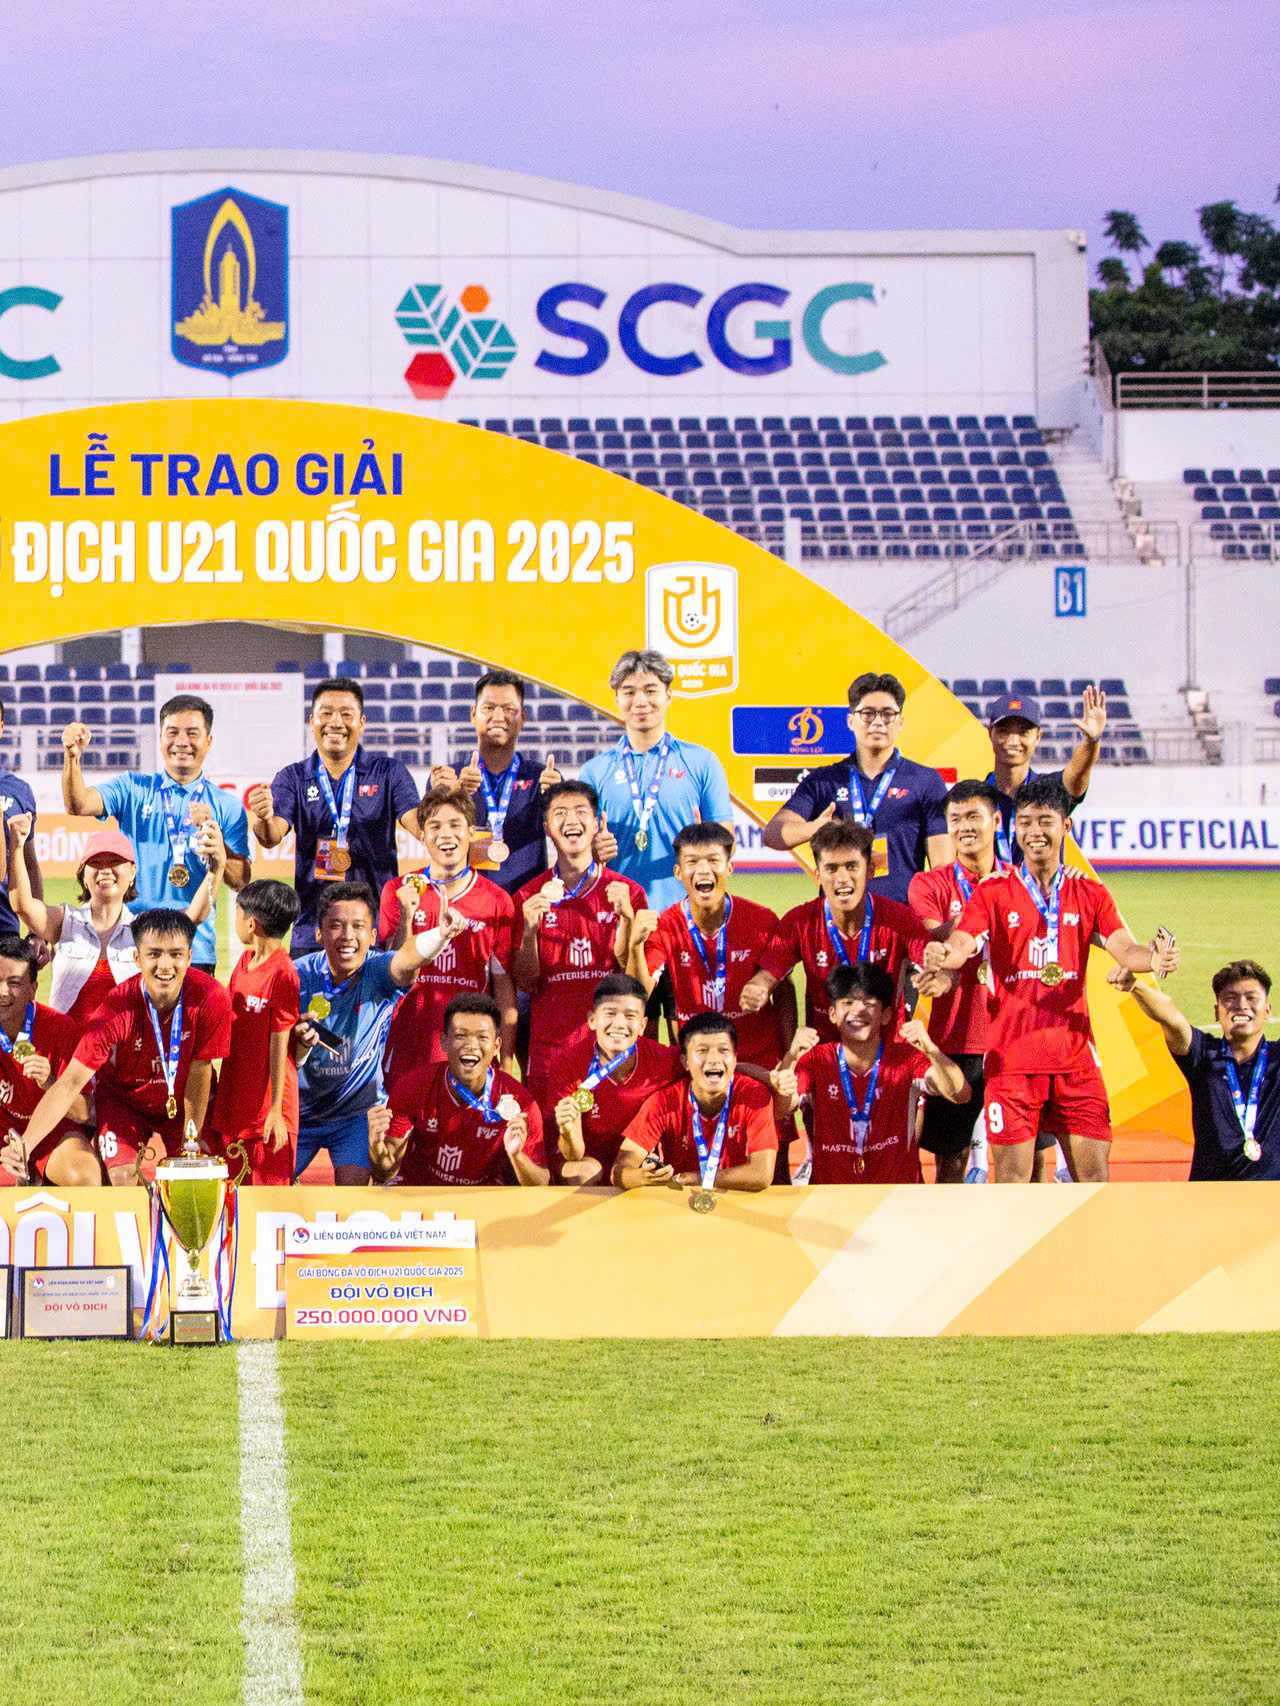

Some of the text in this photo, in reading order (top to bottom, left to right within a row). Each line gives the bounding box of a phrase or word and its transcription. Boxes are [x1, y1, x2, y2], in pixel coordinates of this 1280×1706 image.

[534, 281, 888, 377] SCGC
[50, 432, 404, 497] LỄ TRAO GIẢI
[10, 519, 141, 597] ĐỊCH
[147, 519, 245, 584] U21
[255, 501, 397, 584] QUỐC
[407, 518, 496, 584] GIA
[507, 519, 635, 584] 2025
[1058, 572, 1083, 612] B1
[34, 826, 88, 863] BÓN
[415, 974, 452, 985] ASTERISE
[988, 1102, 1004, 1134] 9
[313, 1230, 334, 1241] LIÊN
[363, 1229, 388, 1240] BÓNG
[425, 1230, 447, 1239] NAM
[389, 1267, 402, 1277] U21
[428, 1267, 442, 1276] GIA
[443, 1267, 464, 1276] 2025
[330, 1283, 433, 1301] ĐỘI VÔ ĐỊCH
[65, 1301, 80, 1311] VÔ
[296, 1308, 467, 1324] 250.000.000 VNĐ
